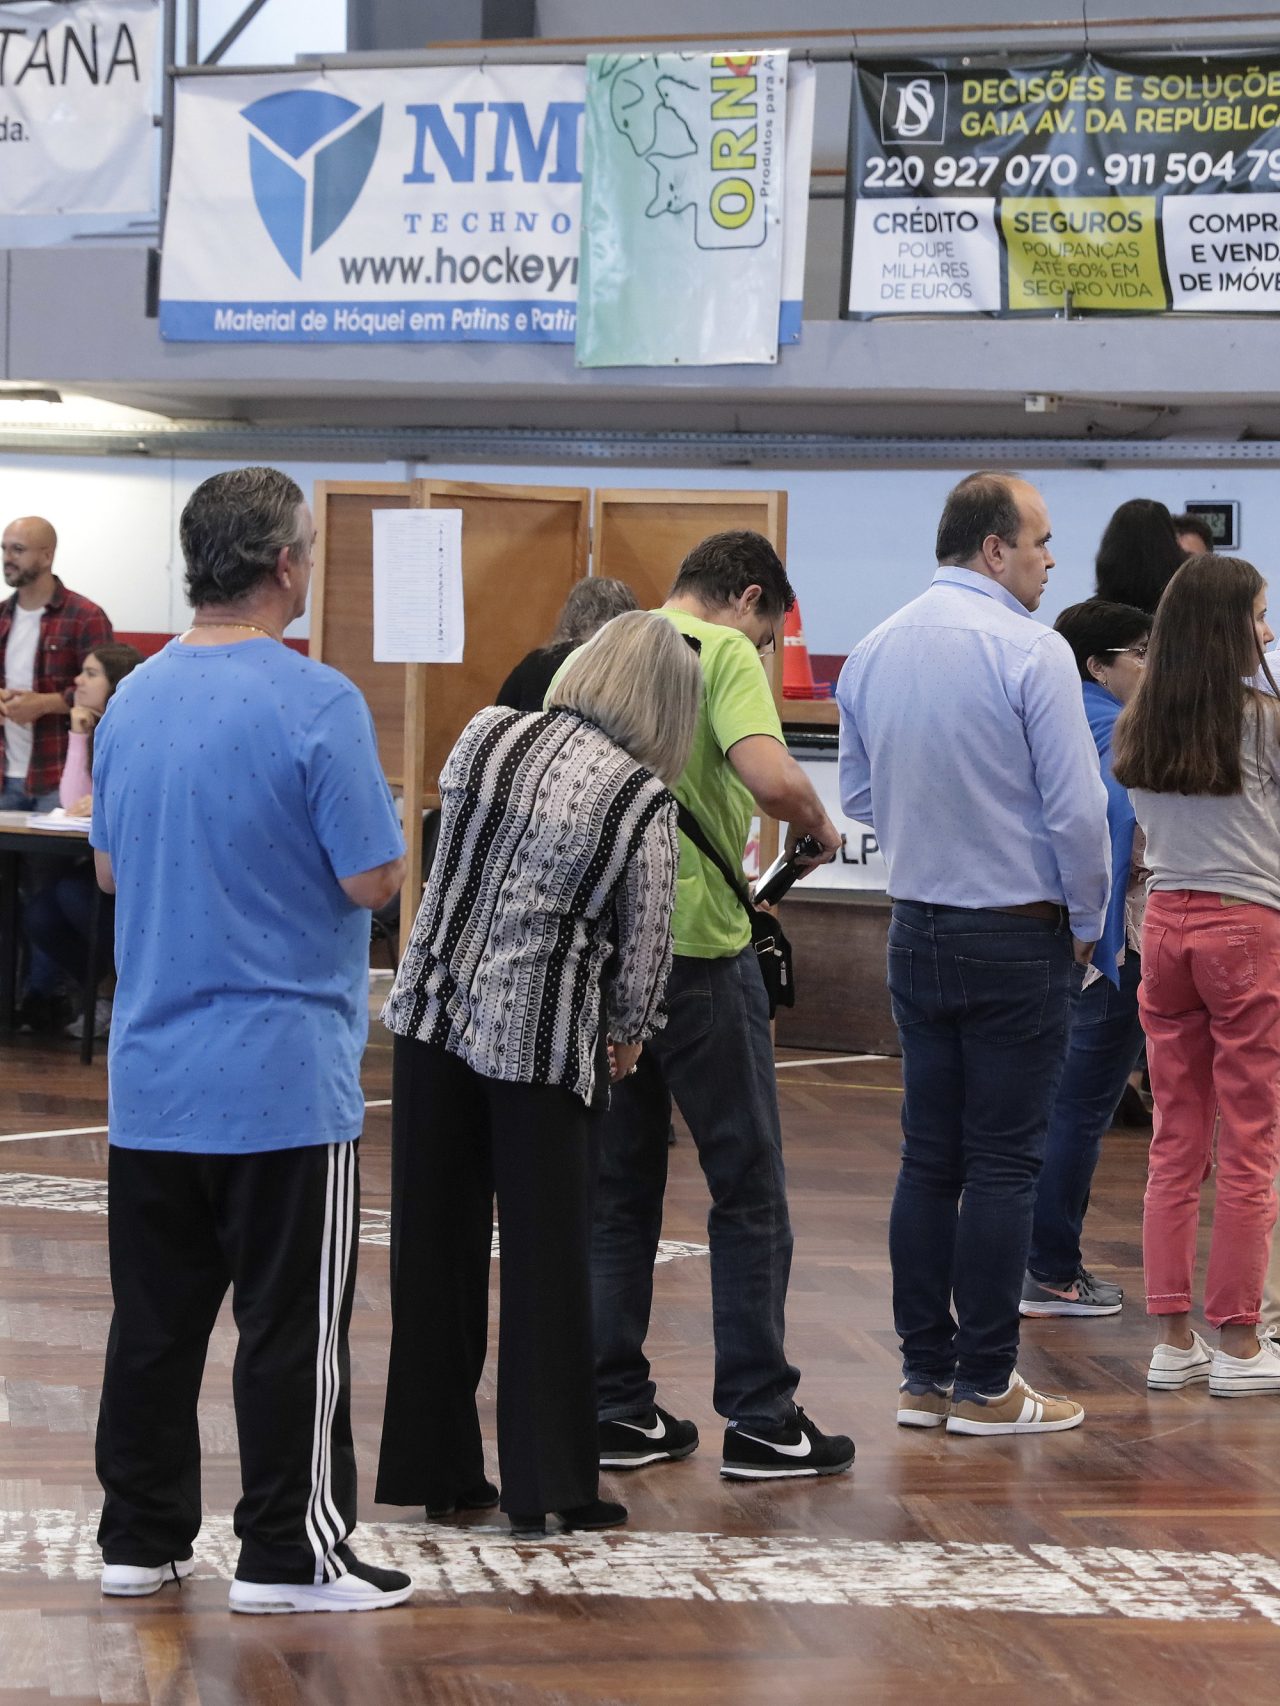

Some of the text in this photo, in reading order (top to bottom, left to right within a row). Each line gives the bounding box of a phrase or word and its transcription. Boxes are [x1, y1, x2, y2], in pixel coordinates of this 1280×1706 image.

[765, 75, 776, 113] para
[961, 70, 1105, 105] DECISÕES
[1114, 76, 1134, 101] E
[960, 111, 1029, 137] GAIA
[1035, 108, 1077, 136] AV.
[1085, 108, 1128, 134] DA
[760, 119, 774, 198] Produtos
[863, 155, 925, 188] 220
[933, 155, 1000, 188] 927
[1005, 154, 1078, 187] 070
[1104, 153, 1156, 186] 911
[1164, 150, 1236, 185] 504
[404, 211, 572, 234] TECHNO
[873, 206, 979, 235] CRÉDITO
[1013, 210, 1143, 235] SEGUROS
[897, 241, 955, 259] POUPE
[1022, 241, 1140, 261] POUPANÇAS
[1191, 244, 1207, 264] E
[881, 261, 970, 280] MILHARES
[1031, 258, 1139, 279] ATÉ 60% EM
[880, 282, 973, 300] DE EUROS
[1106, 281, 1153, 299] VIDA
[1179, 272, 1213, 292] DE
[214, 308, 296, 332] Material
[301, 309, 327, 332] de
[333, 308, 406, 336] Hóquei
[409, 313, 445, 332] em
[451, 307, 510, 332] Patins
[515, 312, 528, 332] e
[828, 832, 880, 866] LP
